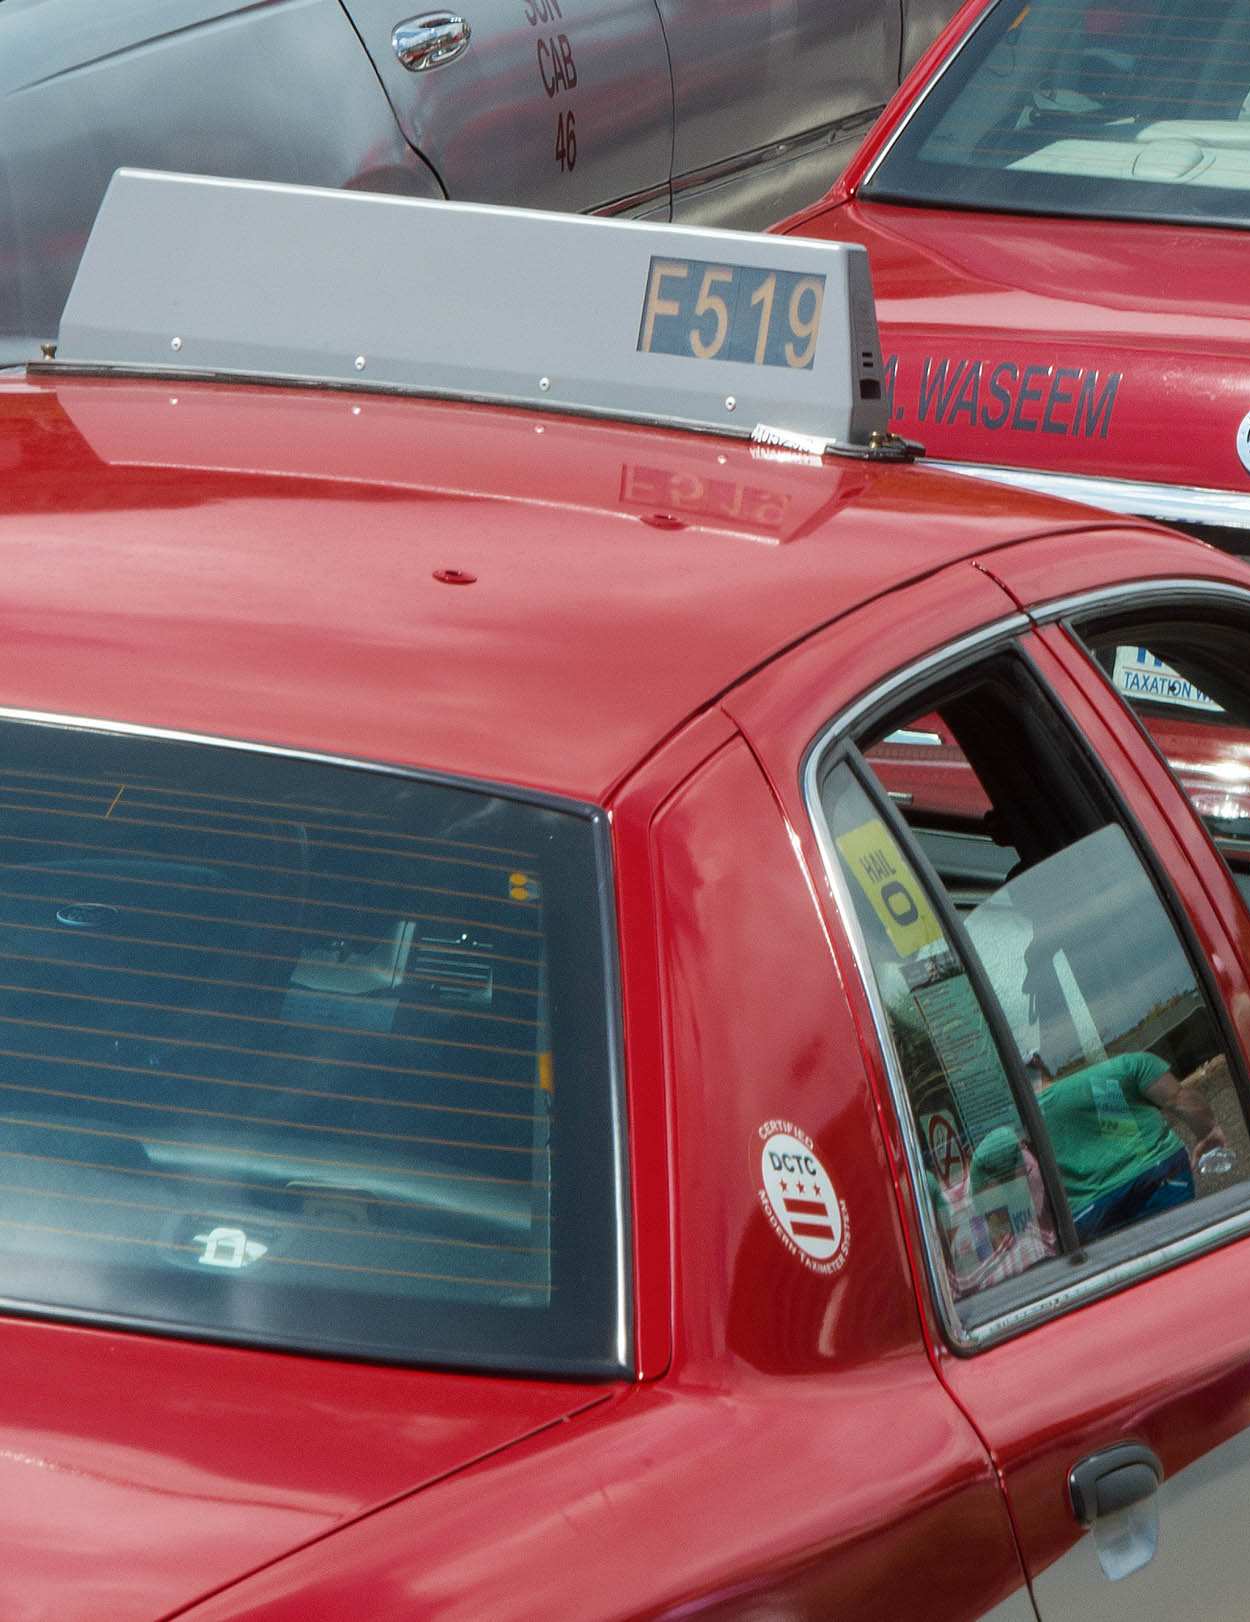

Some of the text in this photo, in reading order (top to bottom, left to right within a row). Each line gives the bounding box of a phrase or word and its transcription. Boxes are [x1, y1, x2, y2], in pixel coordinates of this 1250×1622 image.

[537, 33, 577, 98] CAB
[555, 110, 577, 173] 46
[642, 262, 825, 368] F519
[917, 356, 1124, 439] WASEEM
[1124, 671, 1192, 699] TAXATION
[768, 1151, 817, 1177] DCTC
